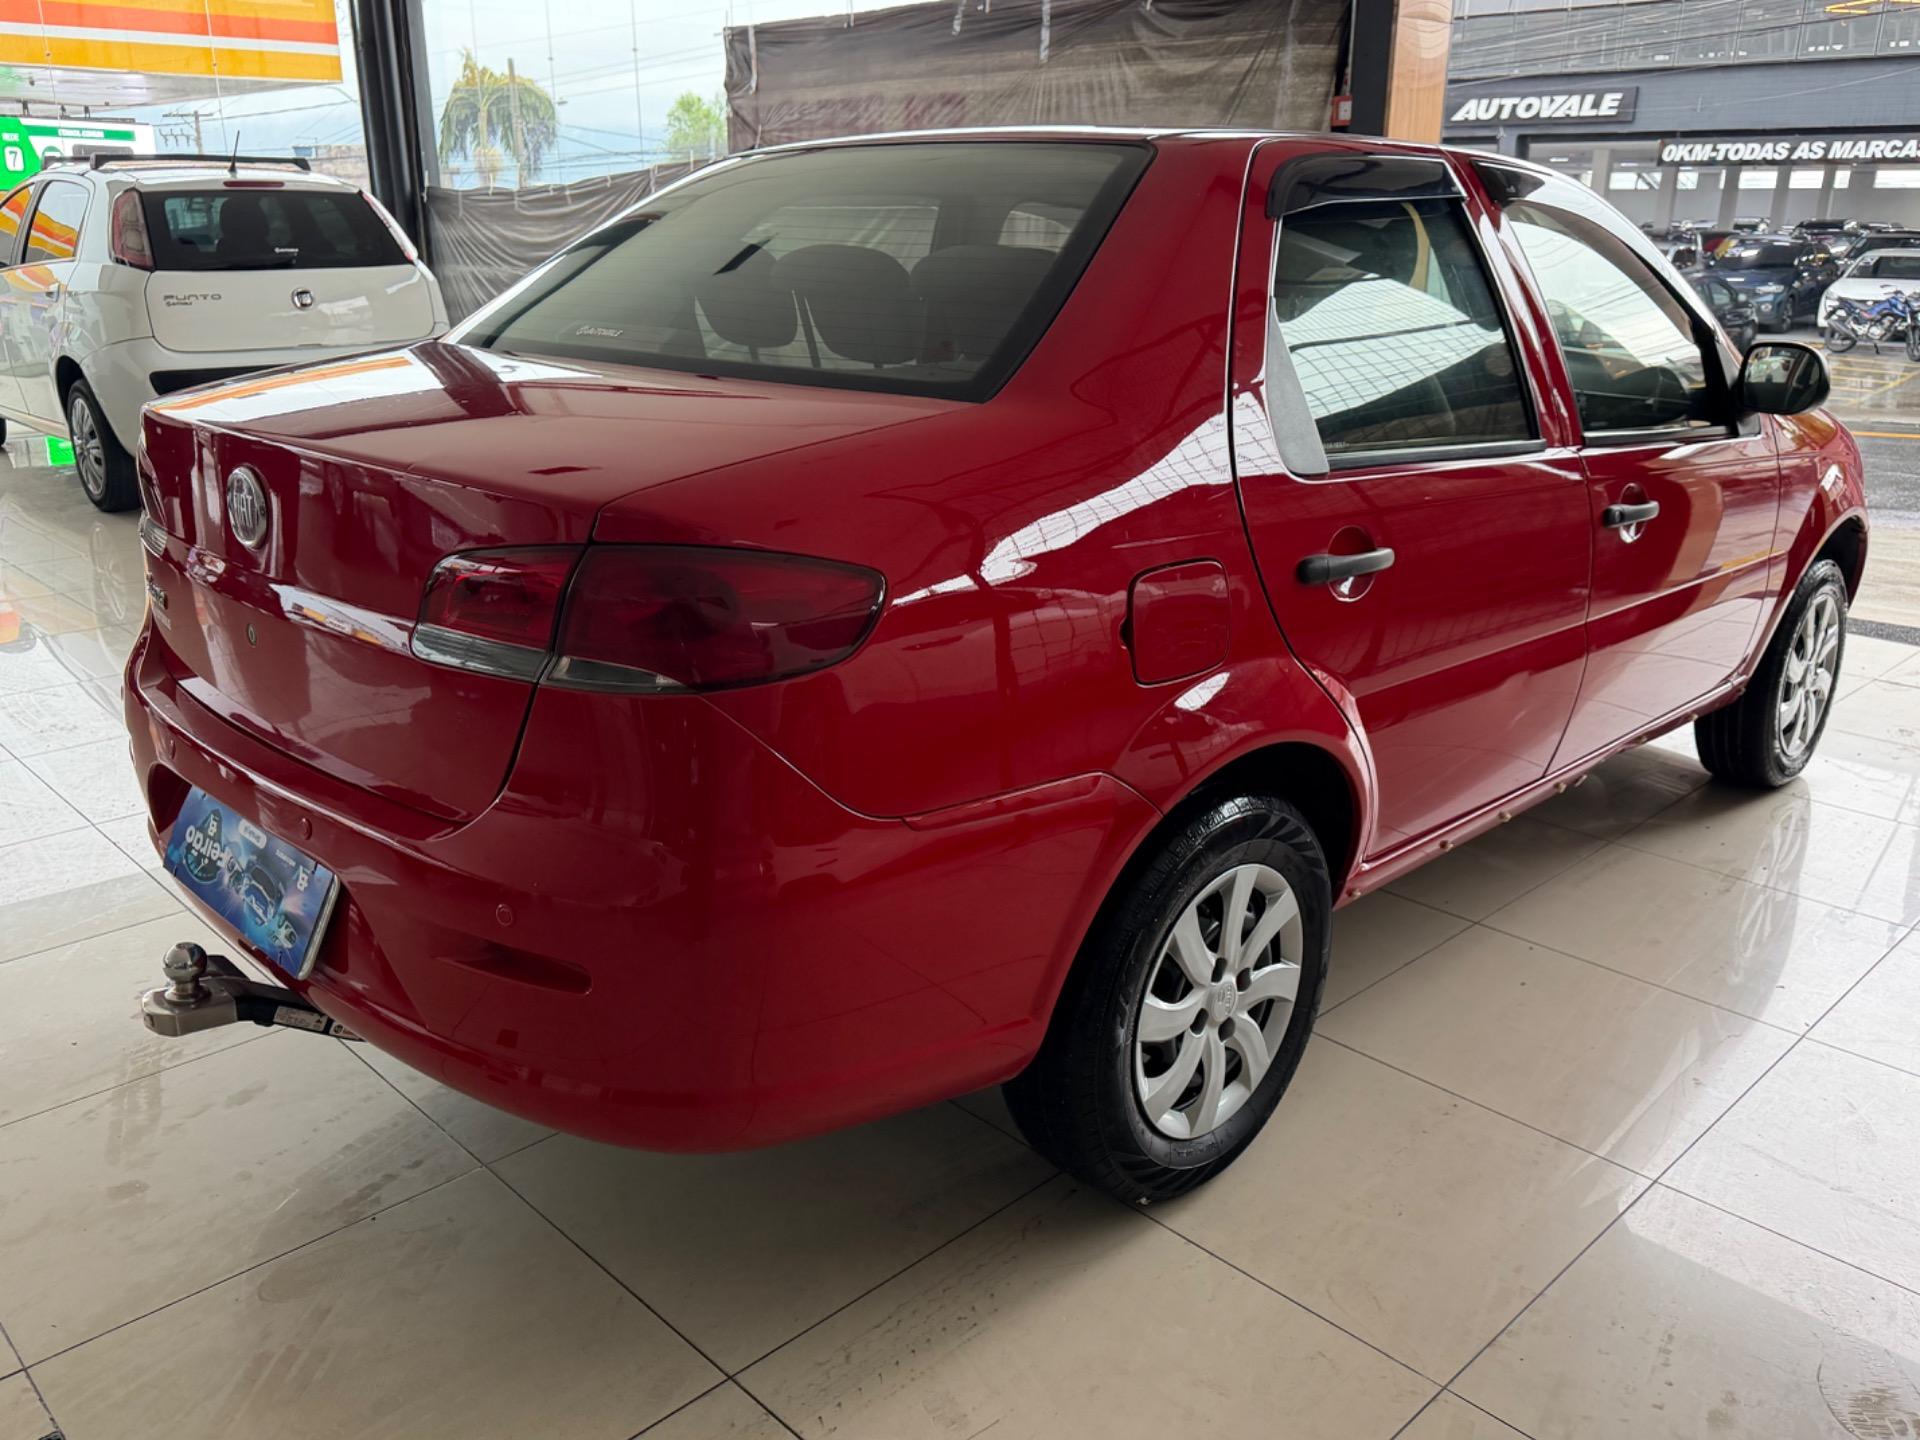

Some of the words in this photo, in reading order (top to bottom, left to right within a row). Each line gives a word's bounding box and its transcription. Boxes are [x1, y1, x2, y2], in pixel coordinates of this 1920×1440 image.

[1450, 92, 1623, 122] AUTOVALE
[8, 150, 18, 168] 7
[1792, 140, 1826, 161] AS
[1828, 138, 1920, 160] MARCA
